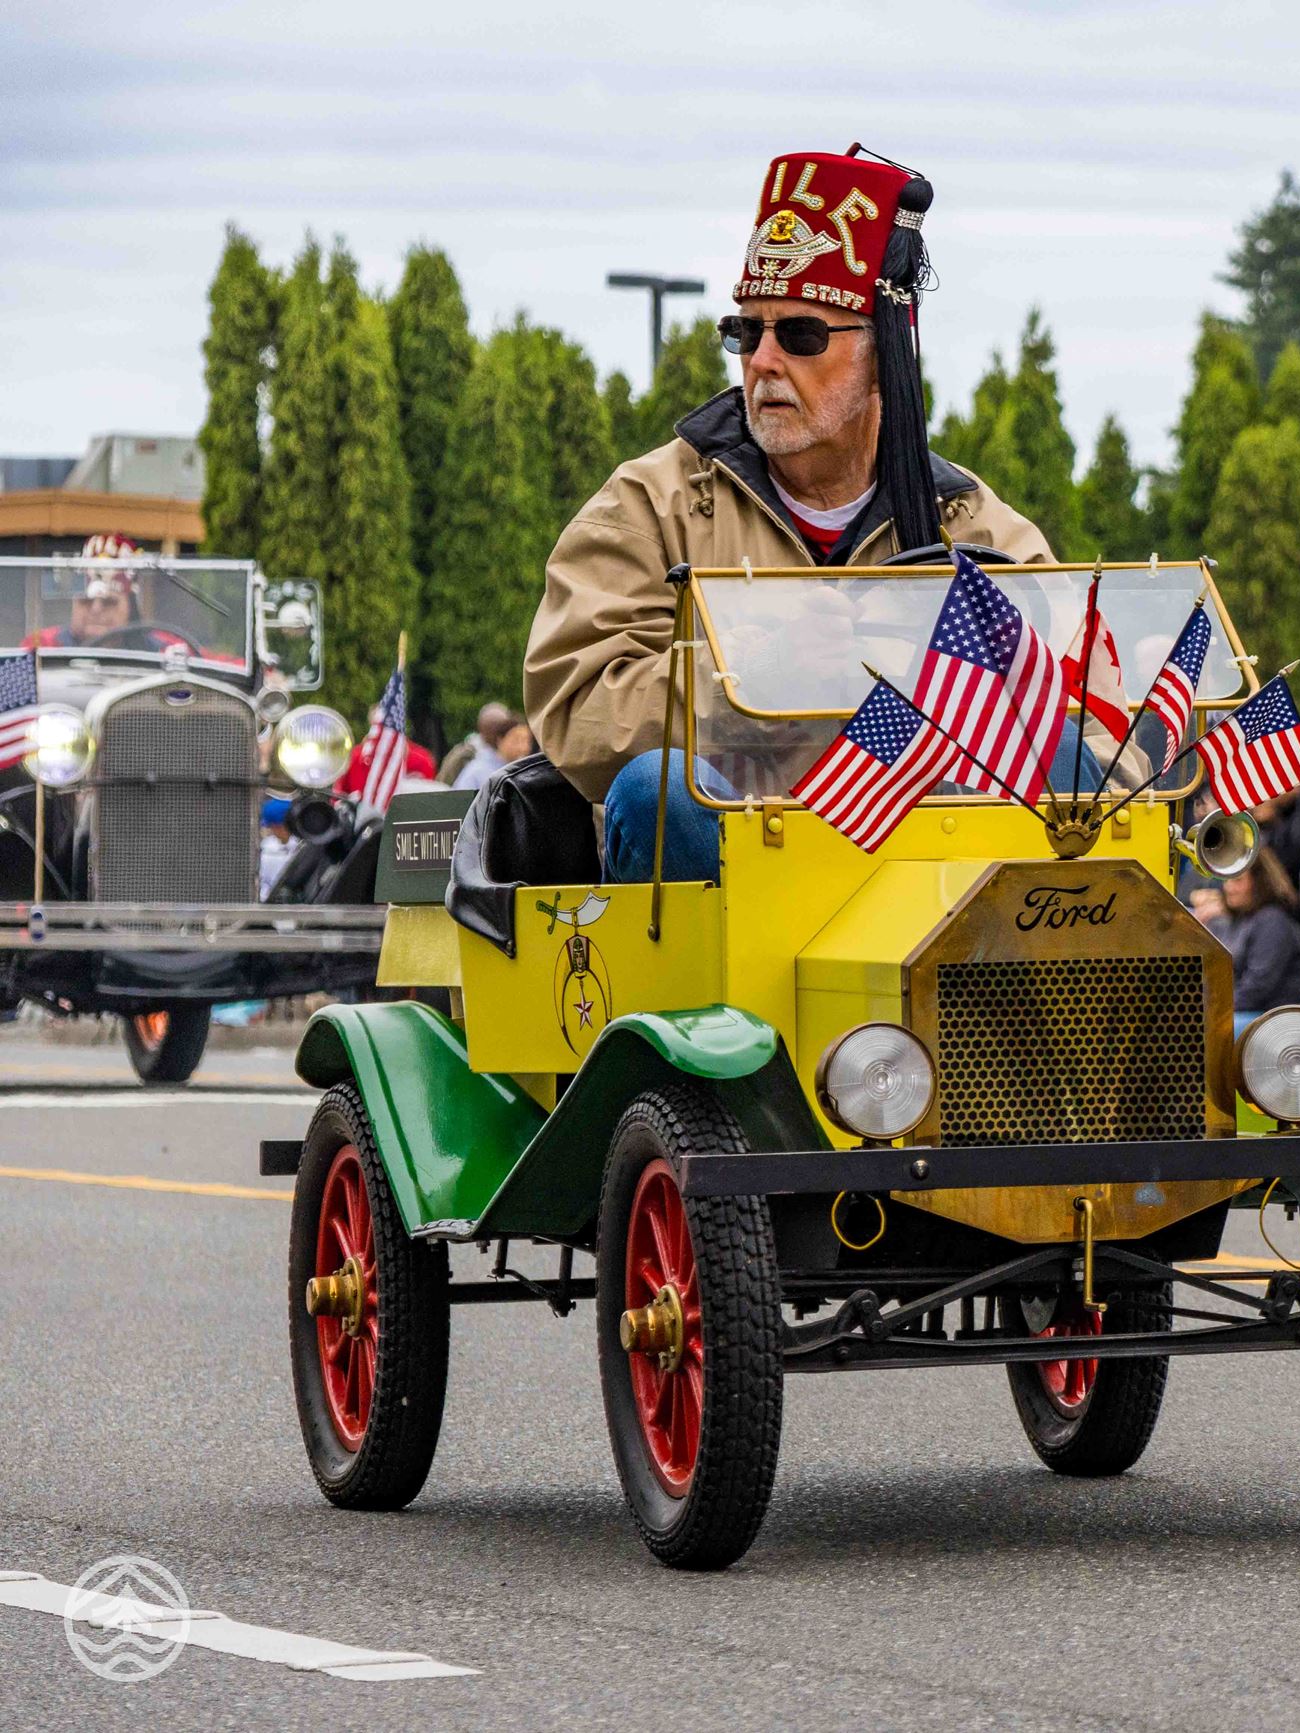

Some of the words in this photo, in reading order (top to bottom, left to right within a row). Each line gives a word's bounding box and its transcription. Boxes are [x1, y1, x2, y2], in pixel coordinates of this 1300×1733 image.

[758, 161, 879, 277] ILE
[801, 282, 866, 311] STAFF
[395, 832, 419, 861] SMILE
[420, 831, 439, 860] WITH
[1015, 885, 1117, 932] Ford
